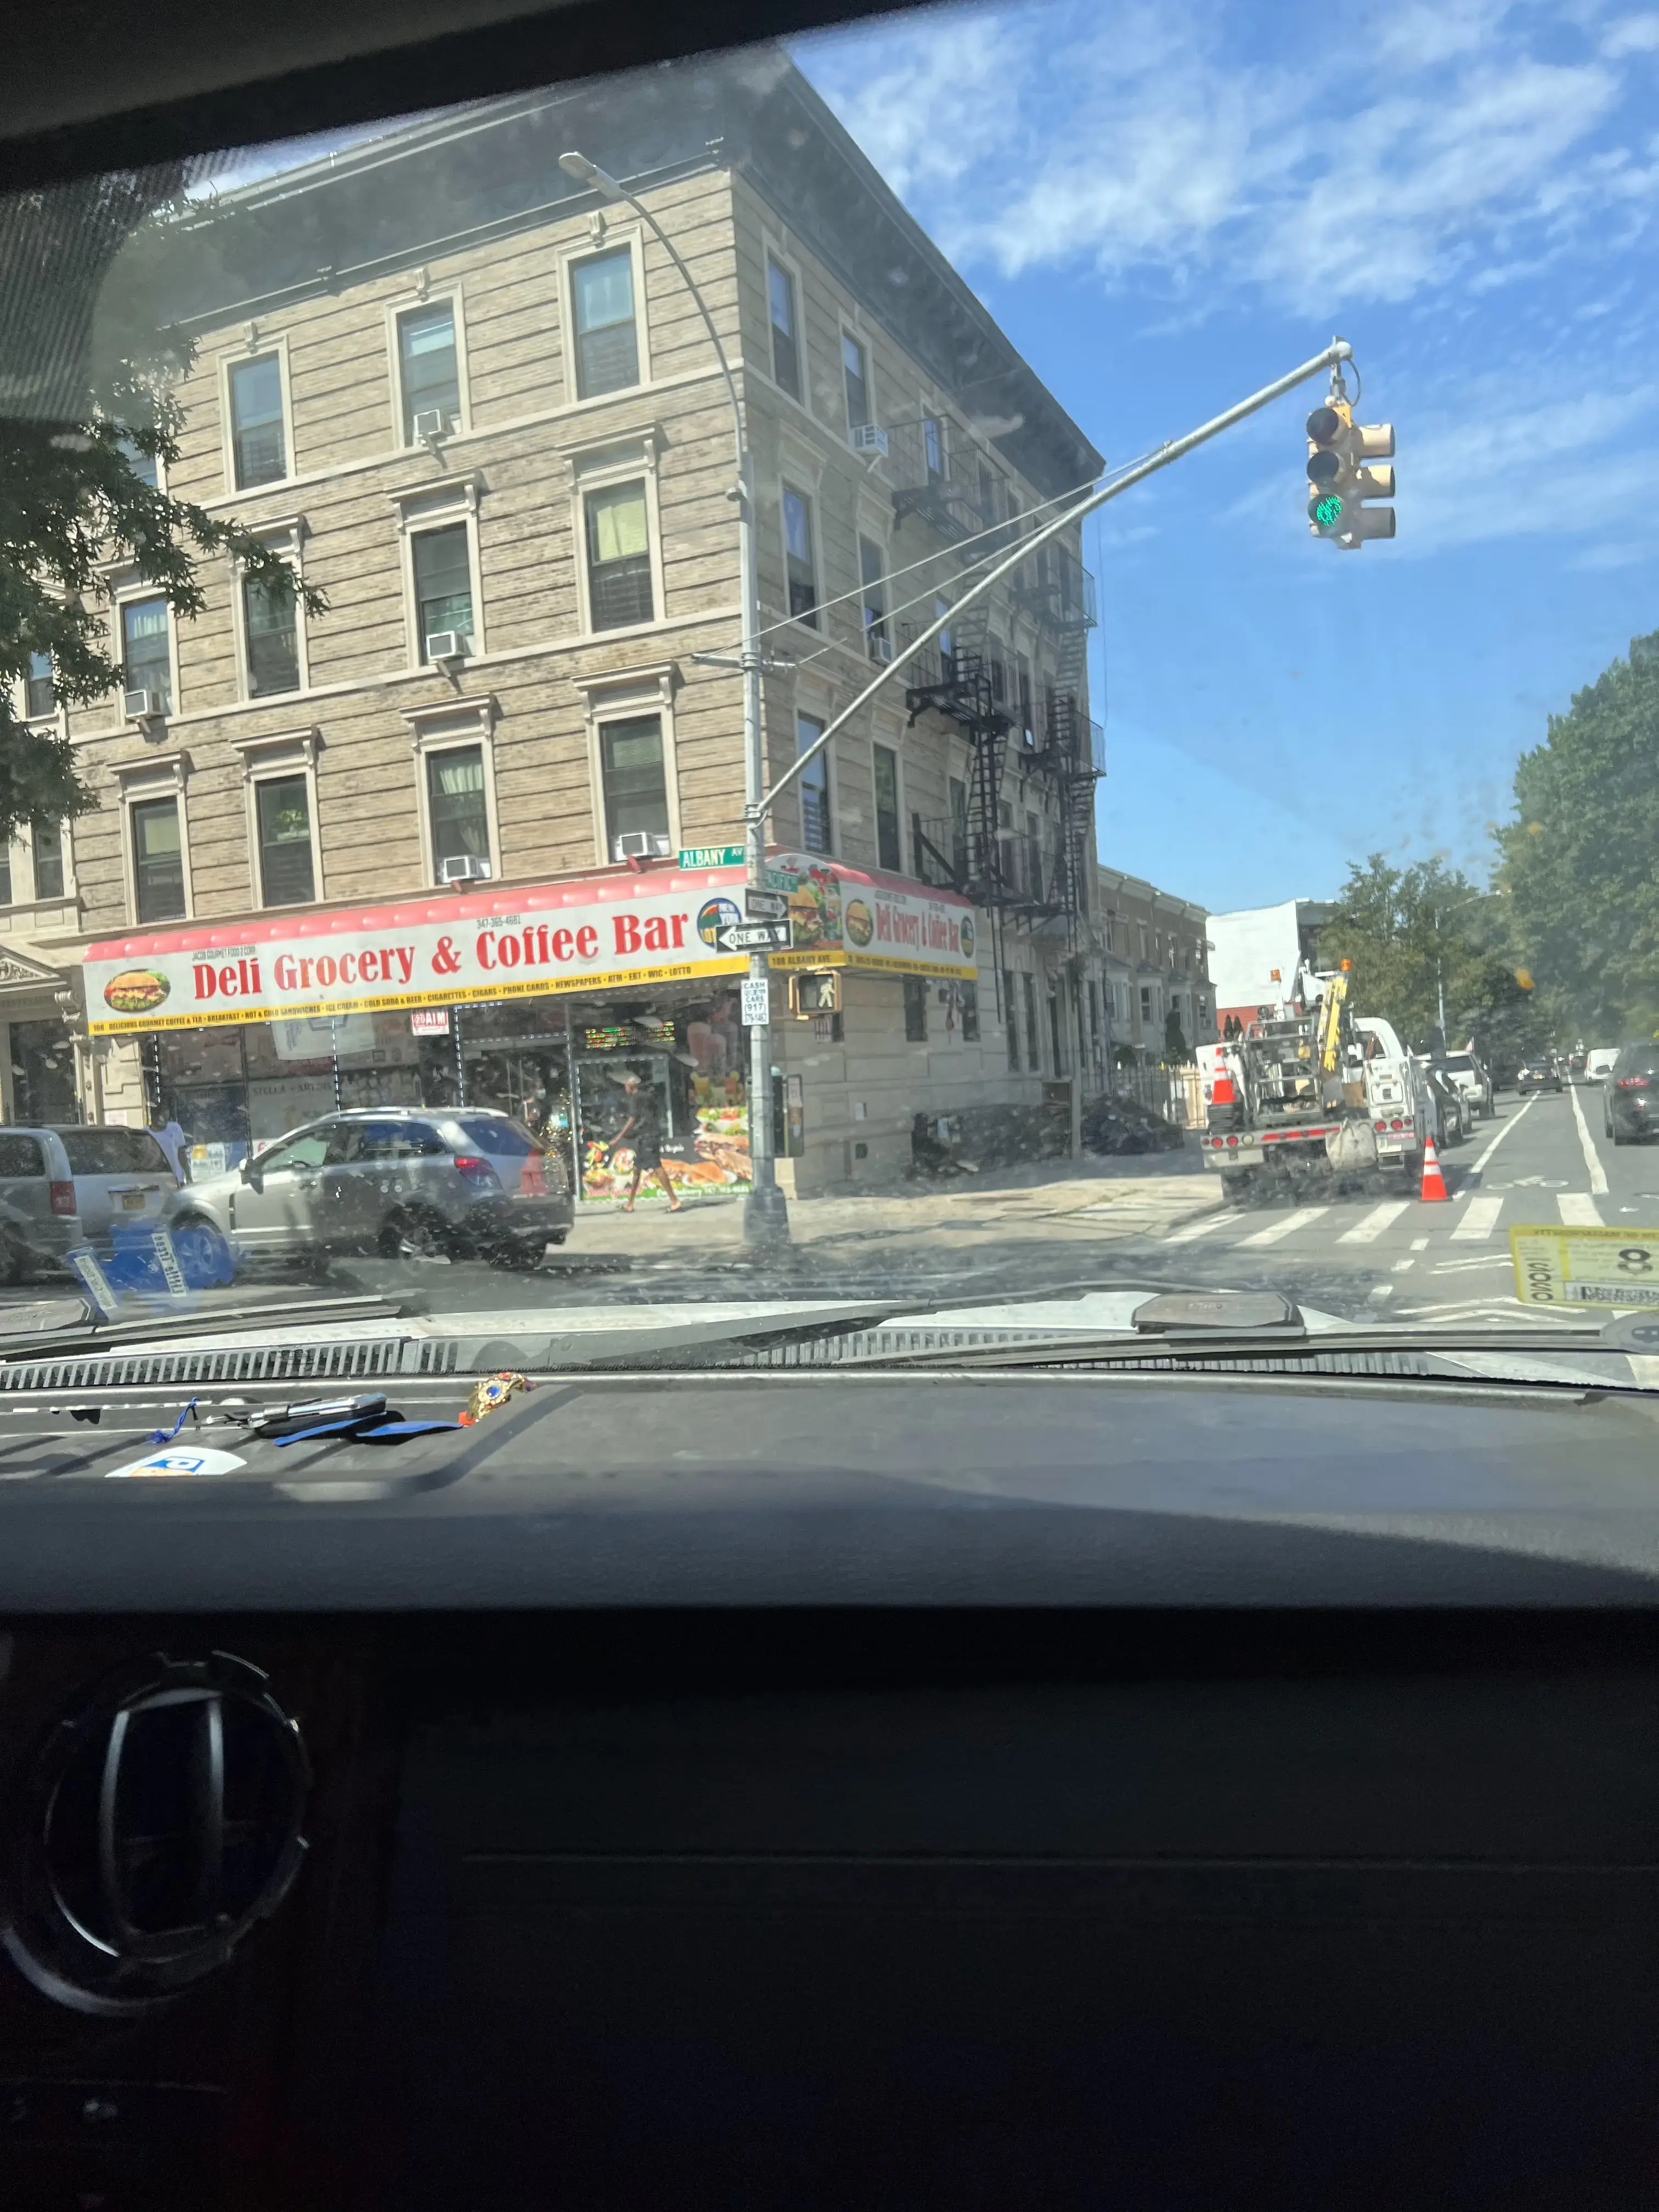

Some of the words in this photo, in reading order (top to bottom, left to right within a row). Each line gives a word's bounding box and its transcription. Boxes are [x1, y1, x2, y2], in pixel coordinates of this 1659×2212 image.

[682, 849, 725, 867] ALBANY
[752, 898, 766, 911] ONE
[729, 932, 752, 945] ONE
[758, 927, 783, 941] WAY
[193, 957, 262, 1000] Deli
[274, 946, 415, 991] Grocery
[431, 936, 461, 975] &
[476, 924, 599, 970] Coffee
[612, 913, 689, 955] Bar
[788, 956, 816, 964] ALBANY
[818, 955, 831, 963] AVE
[109, 1021, 137, 1031] DELICIOUS
[139, 1019, 165, 1028] GOURMET
[166, 1017, 185, 1026] COFFEE
[207, 1012, 240, 1022] BREAKFAST
[264, 1009, 279, 1017] COLD
[280, 1005, 320, 1015] SANDWICHES
[337, 1002, 358, 1010] CREAM
[364, 1000, 380, 1008] COLD
[382, 997, 399, 1006] SODA
[427, 991, 466, 1002] CIGARETTES
[472, 988, 497, 997] CIGARS
[503, 985, 524, 994] PHONE
[527, 982, 549, 991] CARDS
[555, 977, 601, 988] NEWSPAPERS
[608, 974, 622, 983] ATM
[629, 972, 641, 980] EBT
[648, 970, 663, 978] WIC
[669, 967, 691, 976] LOTTO
[1618, 1249, 1654, 1275] 8
